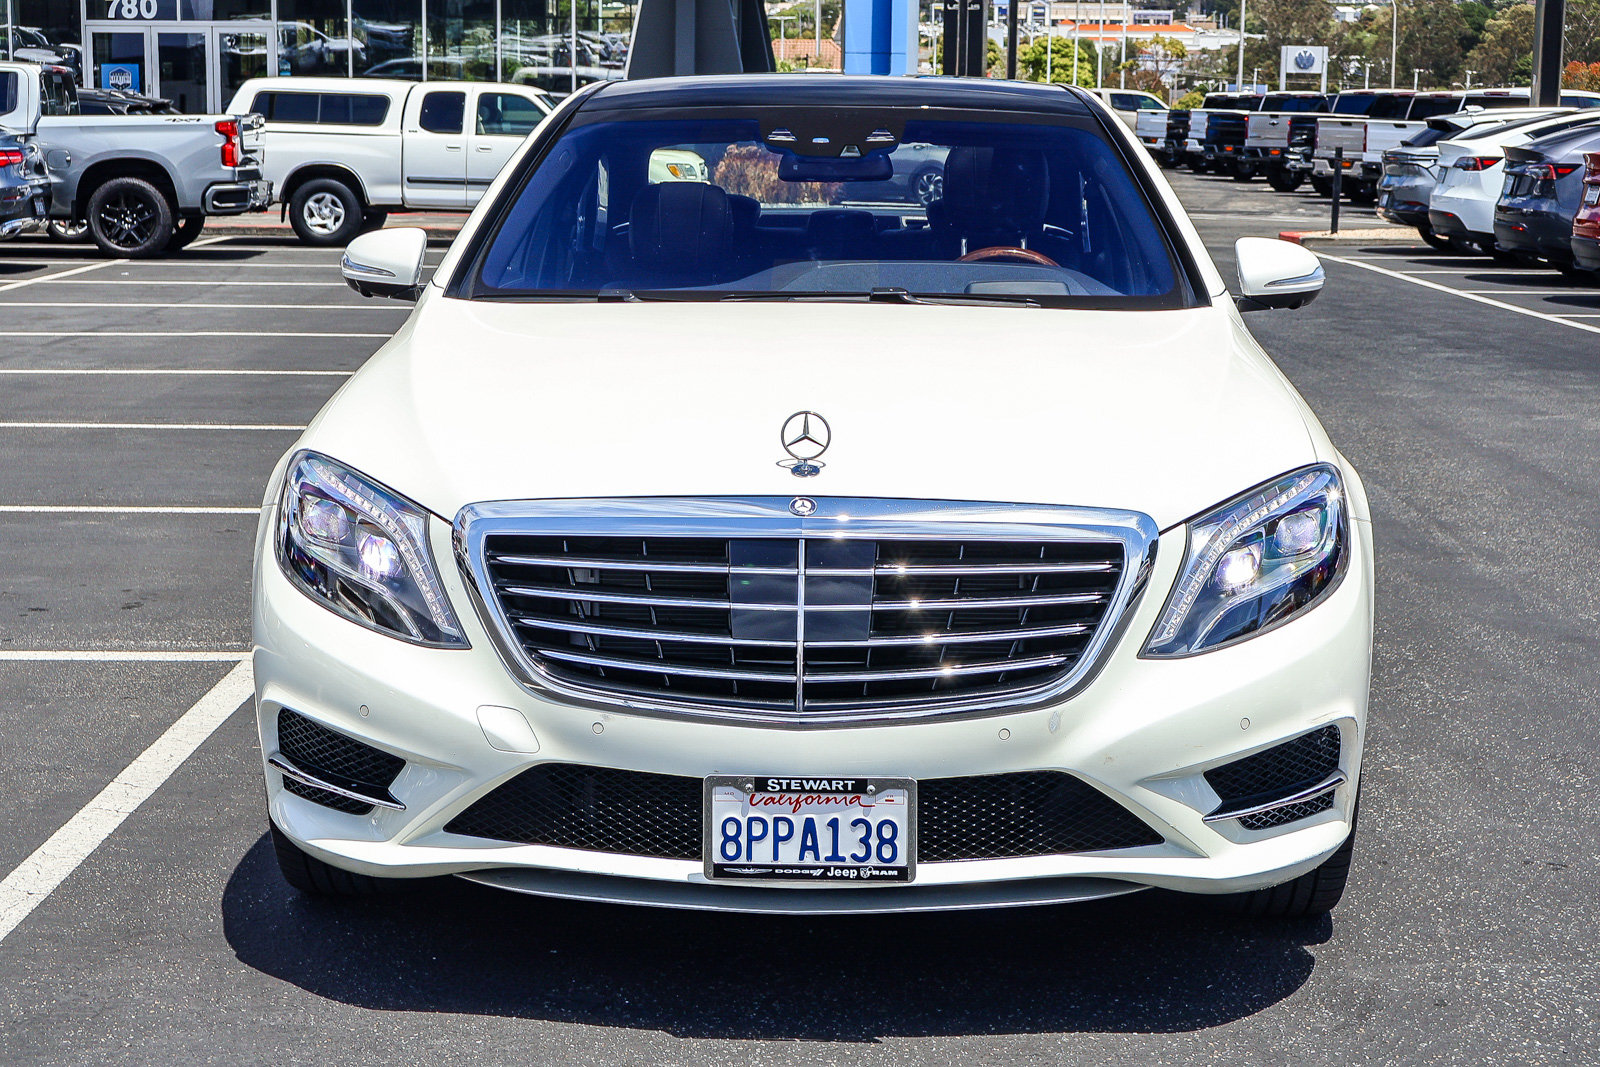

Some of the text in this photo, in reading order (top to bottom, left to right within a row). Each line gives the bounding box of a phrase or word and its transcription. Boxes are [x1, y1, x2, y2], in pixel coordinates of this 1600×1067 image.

[107, 0, 157, 19] 780
[767, 778, 855, 791] STEWART
[720, 816, 898, 863] 8PPA138
[826, 866, 858, 879] Jeep
